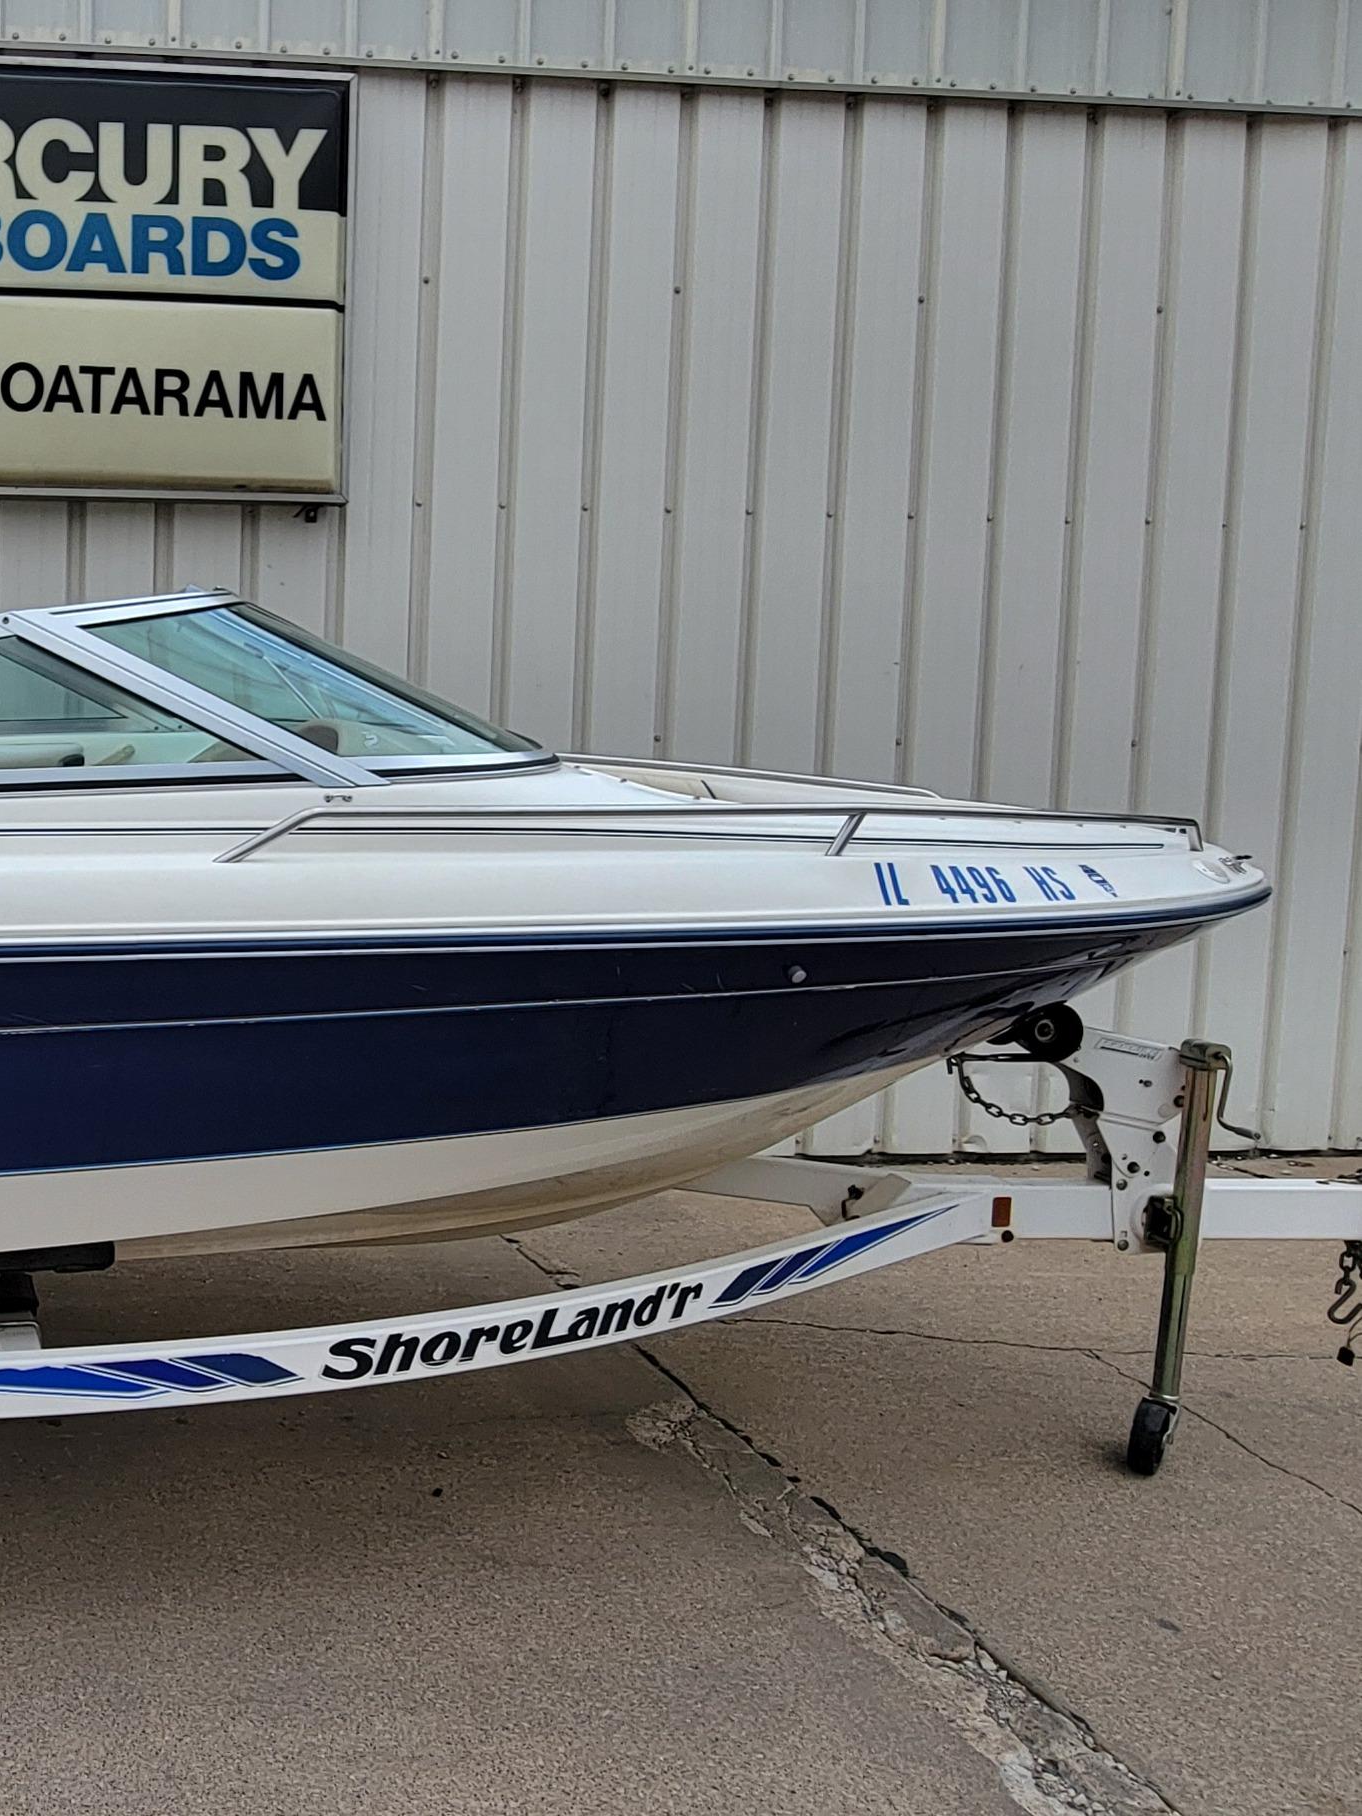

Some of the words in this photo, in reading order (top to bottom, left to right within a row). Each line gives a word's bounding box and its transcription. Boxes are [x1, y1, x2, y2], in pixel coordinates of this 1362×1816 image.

[874, 862, 910, 906] IL
[930, 864, 1017, 904] 4496
[1022, 866, 1077, 901] HS
